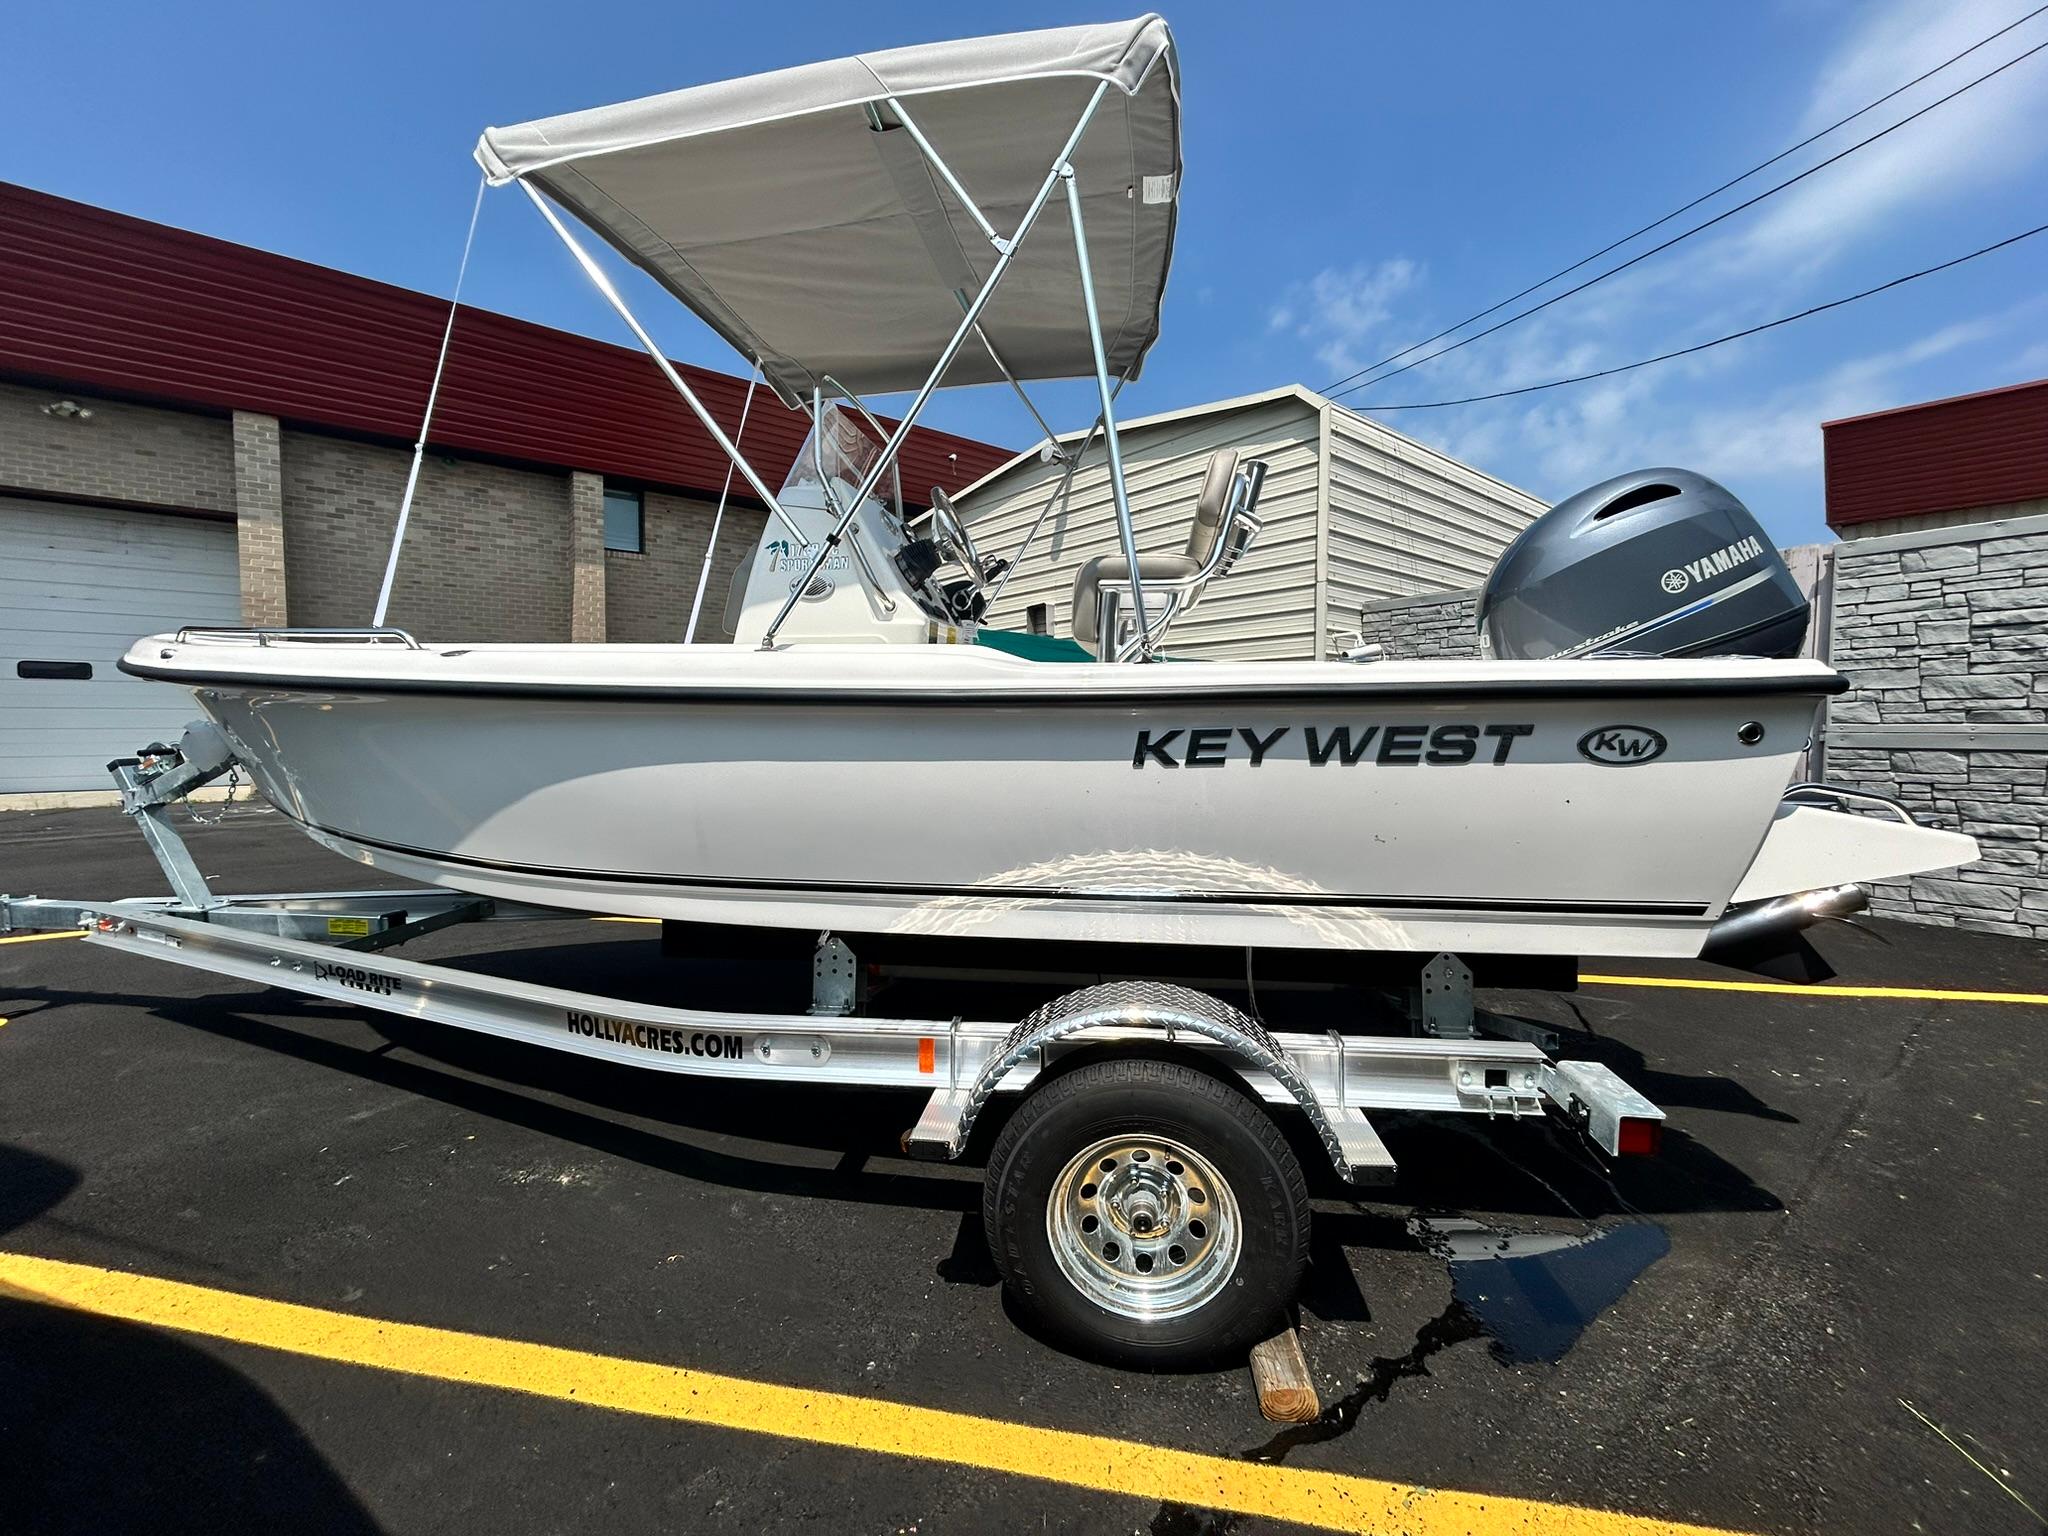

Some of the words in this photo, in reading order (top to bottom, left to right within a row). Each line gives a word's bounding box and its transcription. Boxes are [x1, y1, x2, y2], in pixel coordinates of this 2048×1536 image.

[1684, 535, 1764, 583] YAMAHA
[1132, 726, 1290, 769] KEY
[1304, 724, 1535, 767] WEST
[1594, 733, 1653, 757] KW
[327, 964, 366, 982] LOAD
[368, 971, 402, 990] RITE
[567, 1011, 743, 1060] HOLLYACRES.COM
